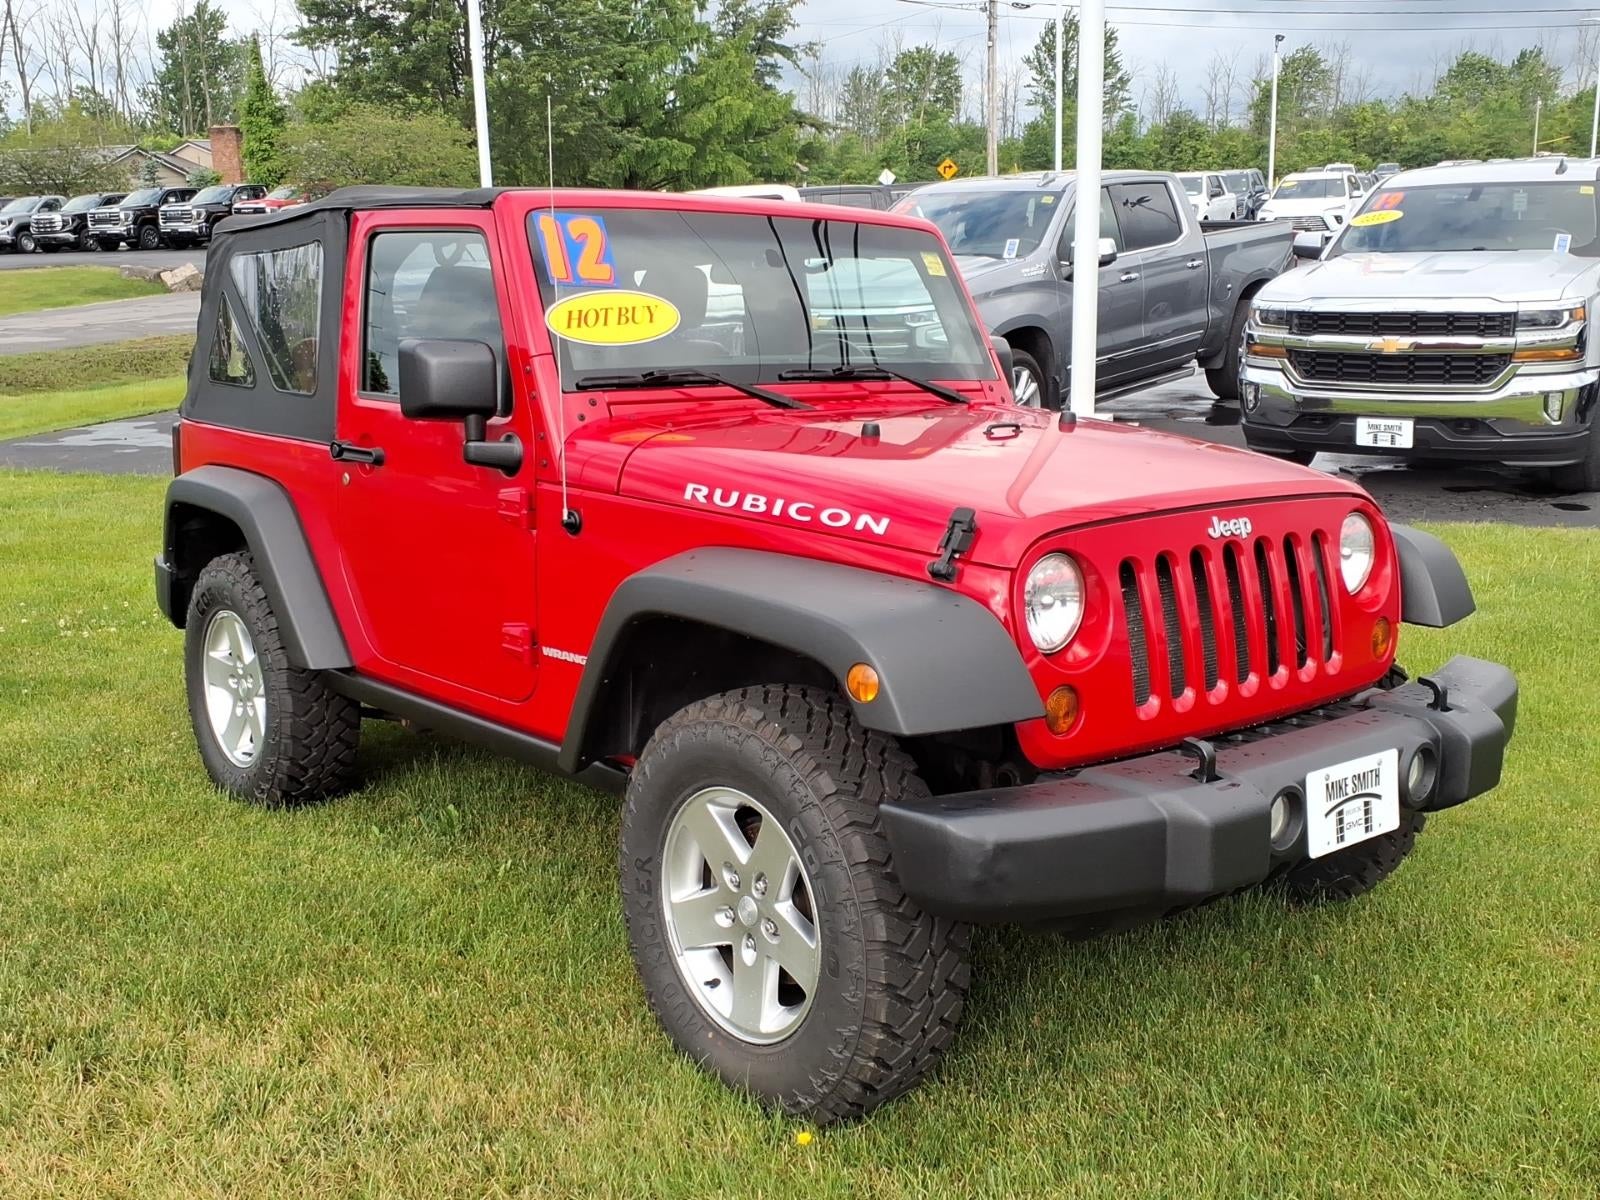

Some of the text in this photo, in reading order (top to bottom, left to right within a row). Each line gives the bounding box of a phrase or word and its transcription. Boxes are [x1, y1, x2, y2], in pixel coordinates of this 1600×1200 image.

[539, 214, 614, 284] 12
[566, 305, 658, 329] HOT BUY
[1367, 423, 1402, 432] MIKE SMITH
[683, 482, 891, 536] RUBICON
[1207, 515, 1252, 539] Jeep
[542, 646, 588, 665] WRANG
[1325, 767, 1381, 802] MIKE SMITH
[1345, 817, 1364, 830] GMC
